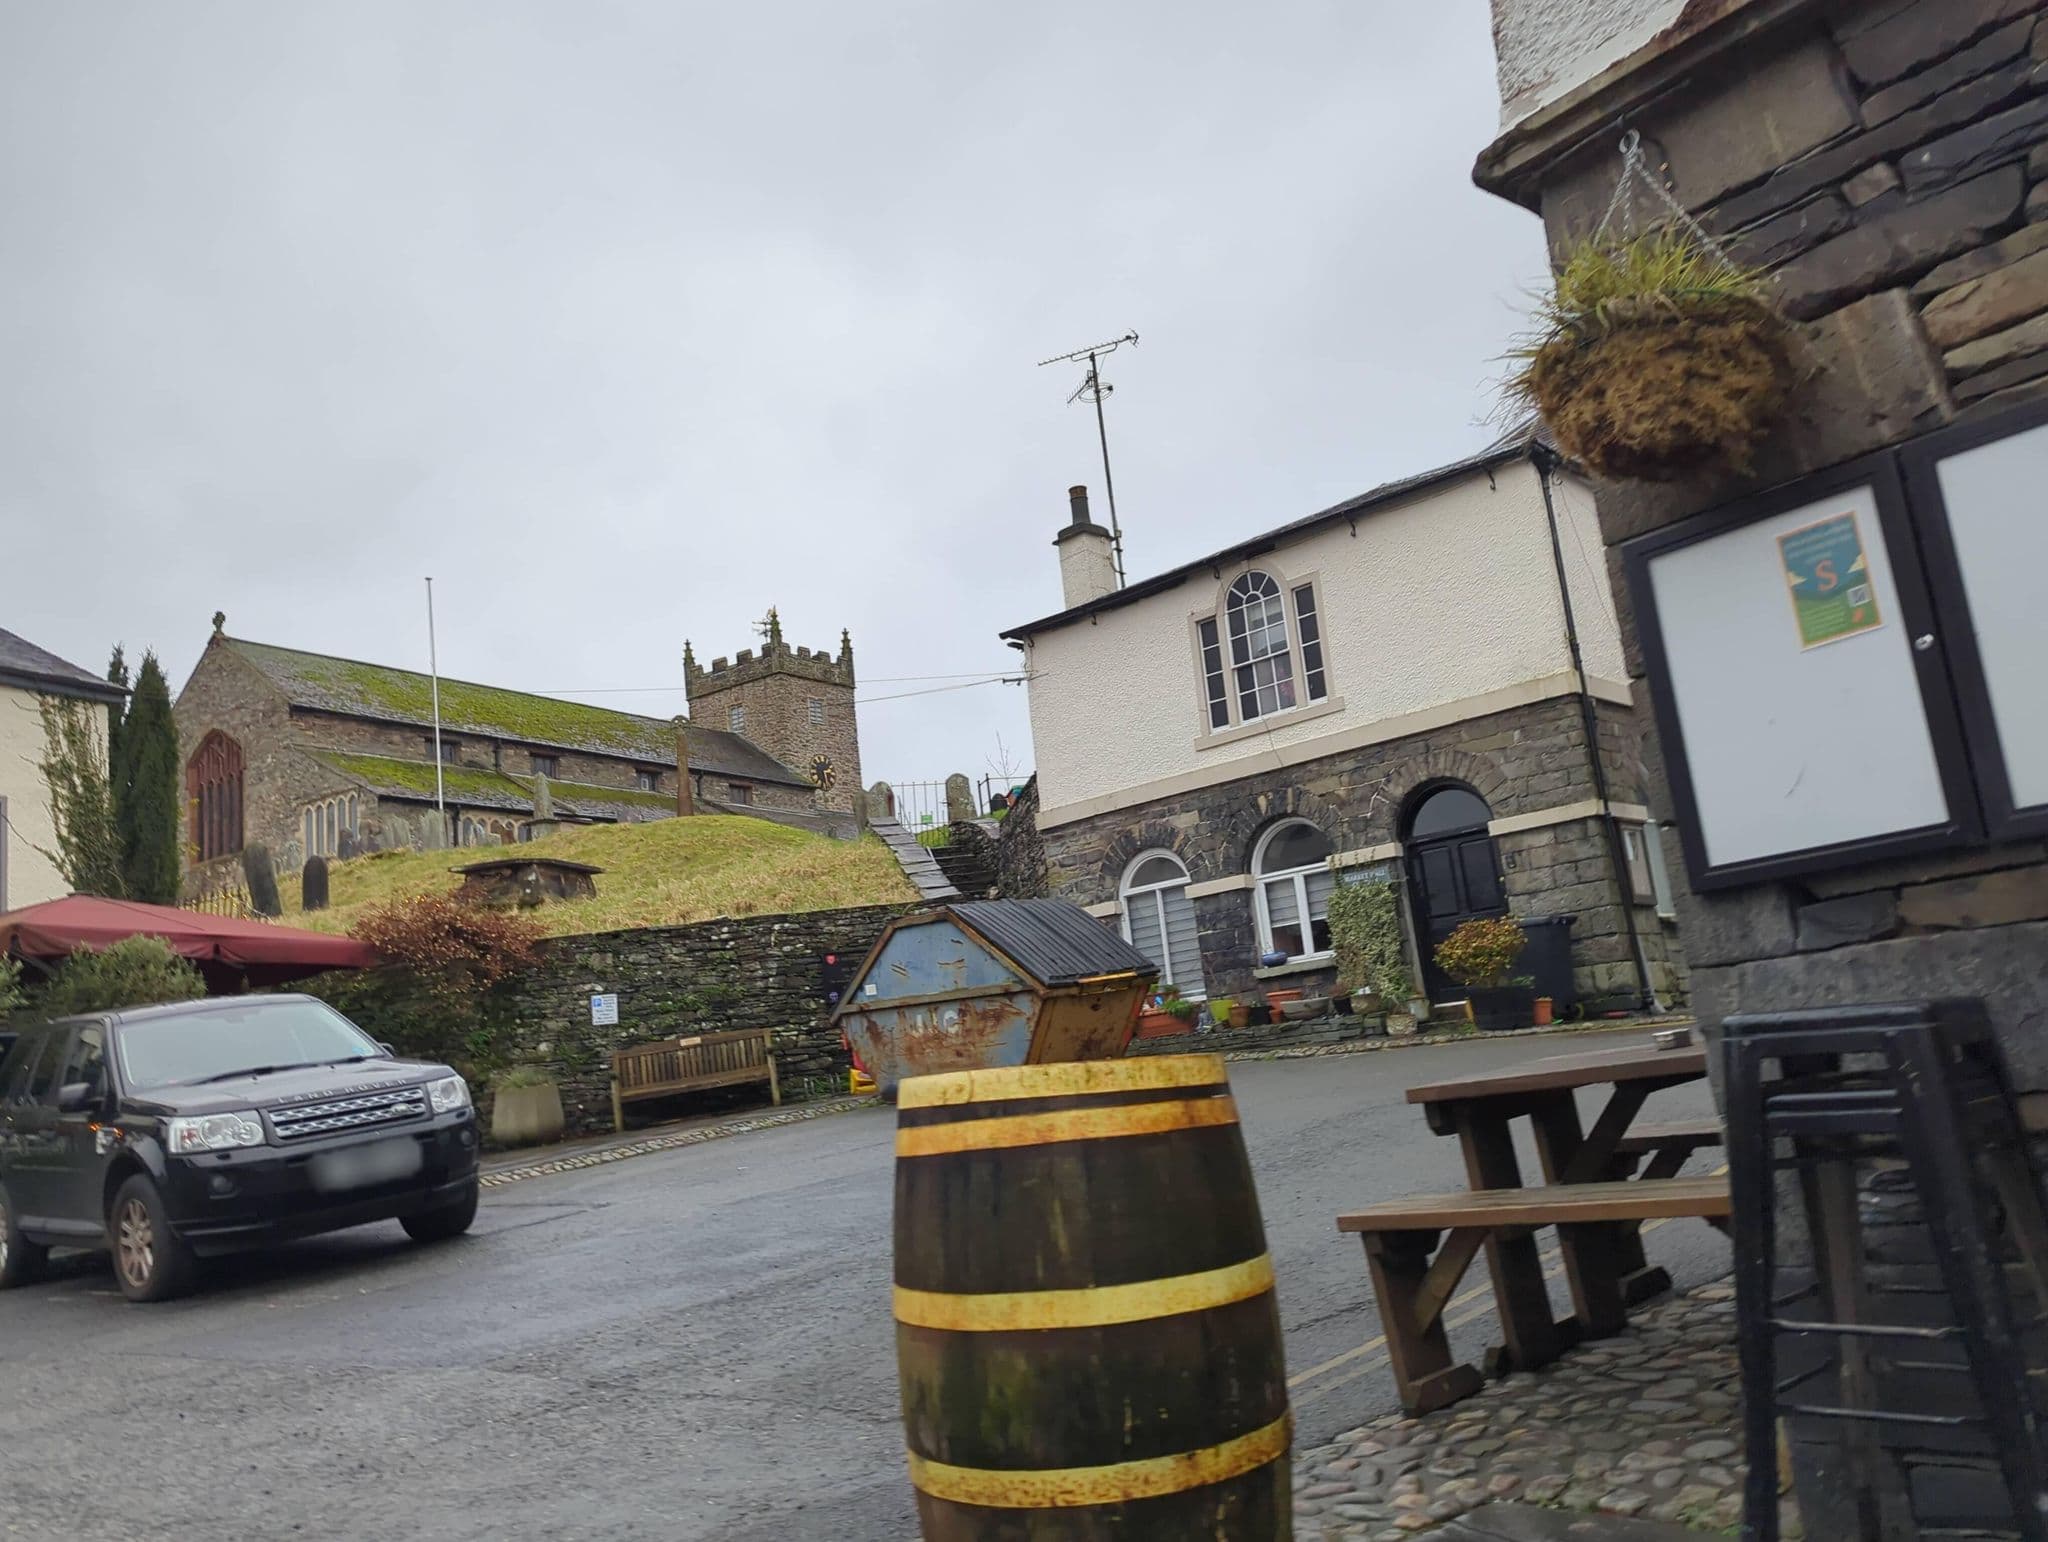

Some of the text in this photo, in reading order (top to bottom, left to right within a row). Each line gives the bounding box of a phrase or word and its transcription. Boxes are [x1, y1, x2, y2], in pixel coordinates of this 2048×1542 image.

[1815, 559, 1839, 592] S
[278, 1079, 407, 1104] LAND ROVER
